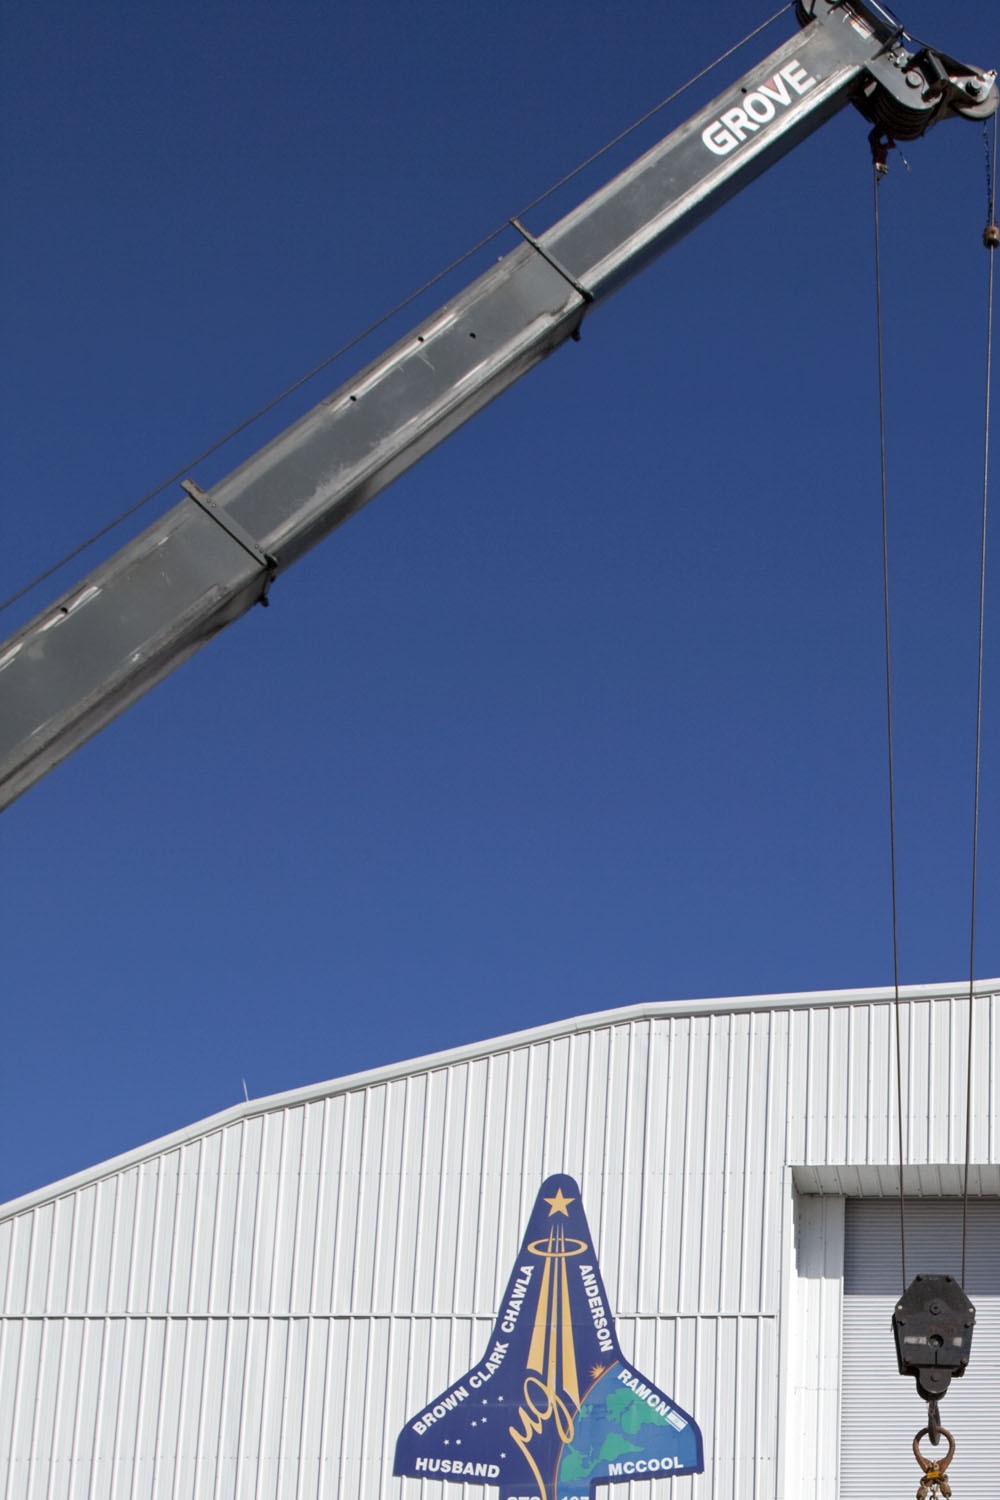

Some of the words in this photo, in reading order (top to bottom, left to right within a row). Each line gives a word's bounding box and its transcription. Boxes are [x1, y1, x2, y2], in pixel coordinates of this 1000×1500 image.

[702, 59, 817, 156] GROVE
[579, 1264, 614, 1353] ANDERSON
[412, 1385, 469, 1436] BROWN
[470, 1341, 509, 1390] CLARK
[502, 1264, 535, 1333] CHAWLA
[617, 1368, 669, 1417] RAMON
[415, 1457, 500, 1479] HUSBAND
[608, 1457, 684, 1475] MCCOOL
